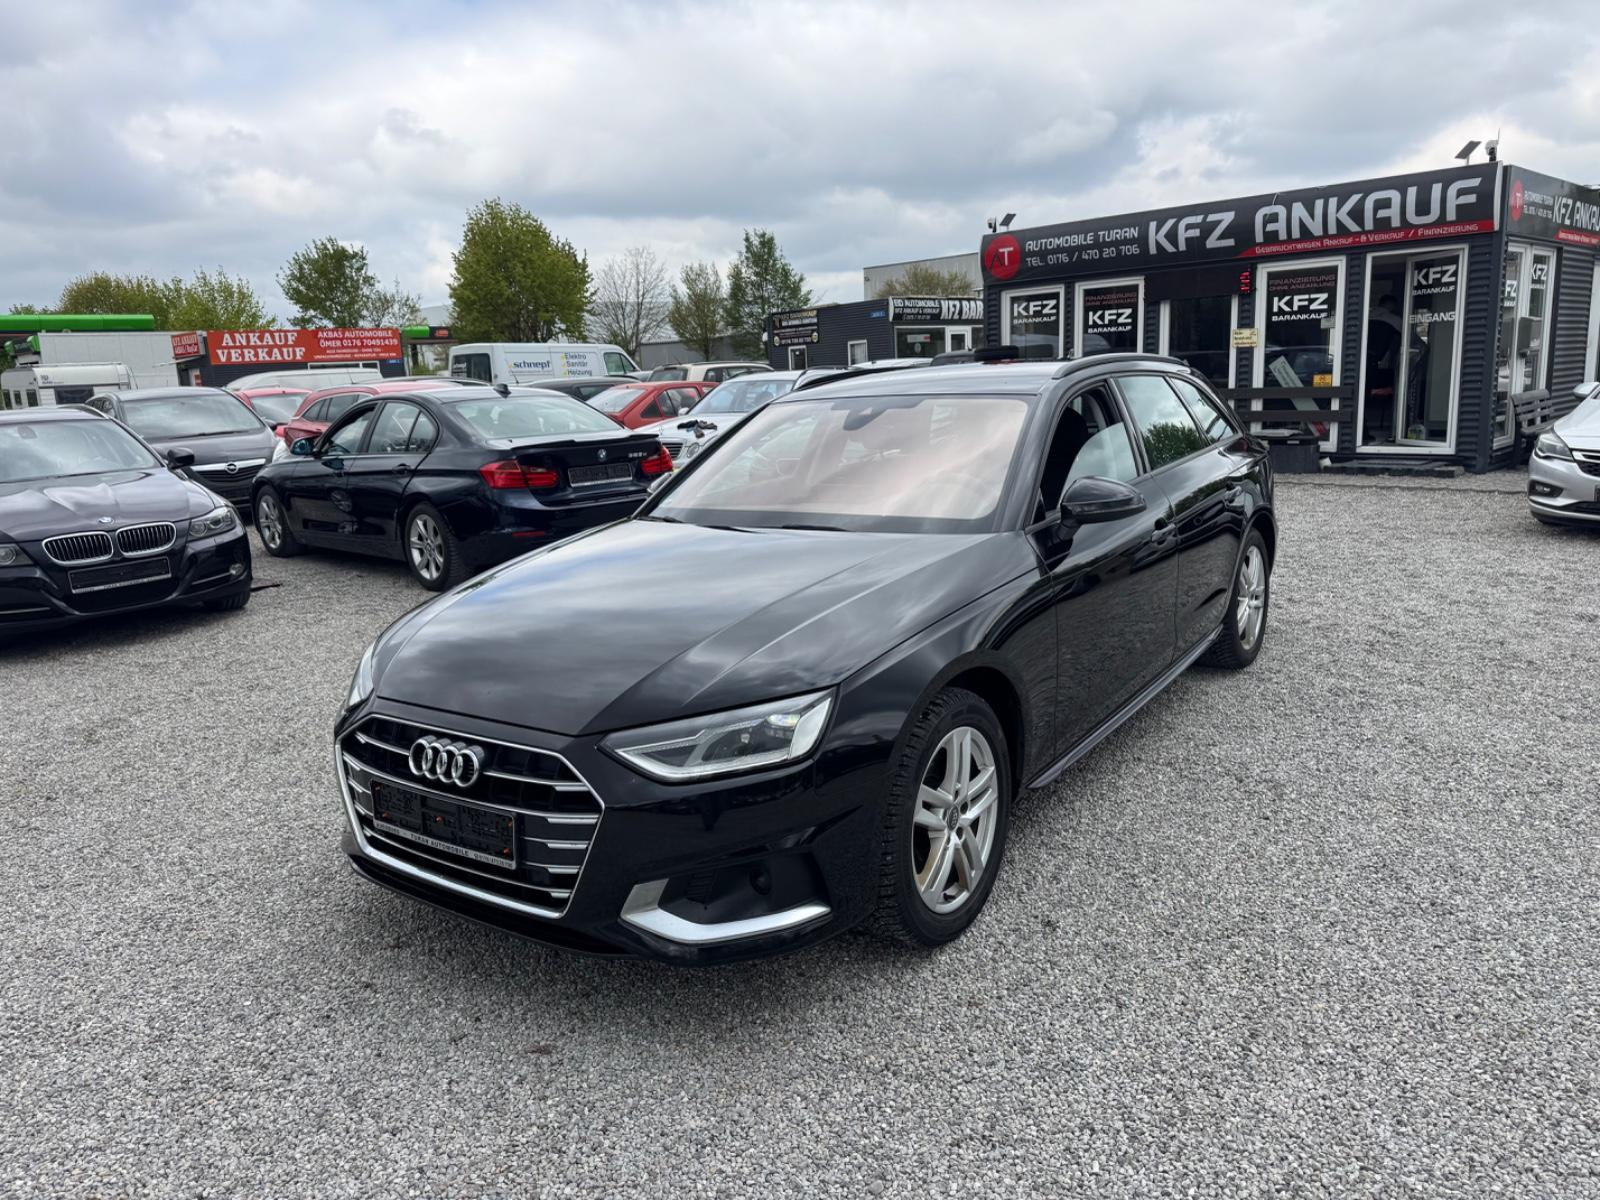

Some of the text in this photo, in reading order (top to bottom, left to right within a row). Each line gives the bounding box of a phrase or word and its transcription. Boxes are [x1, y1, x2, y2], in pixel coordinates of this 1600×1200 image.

[1148, 177, 1482, 255] KFZ ANKAUF
[1553, 195, 1573, 226] KFZ
[1025, 226, 1139, 252] AUTOMOBILE TURAN
[1047, 252, 1069, 265] 0176
[1072, 251, 1079, 262] /
[1082, 249, 1099, 260] 470
[1102, 247, 1117, 258] 20
[1119, 244, 1140, 256] 706
[1412, 264, 1456, 286] KFZ
[1412, 285, 1456, 295] BARANKAUF
[941, 300, 960, 319] KFZ
[1013, 299, 1057, 317] KFZ
[1273, 293, 1328, 312] KFZ
[1013, 315, 1057, 325] BARANKAUF
[1088, 308, 1132, 326] KFZ
[1272, 312, 1328, 322] BARANKAUF
[1408, 311, 1456, 324] EINGANG
[344, 330, 392, 338] AUTOMOBILE
[1087, 325, 1132, 334] BARANKAUF
[221, 332, 298, 347] ANKAUF
[319, 339, 341, 348] ÖMER
[343, 339, 361, 347] 0176
[216, 347, 306, 362] VERKAUF
[565, 352, 586, 360] Elektro
[513, 360, 550, 370] schnepf
[567, 369, 592, 377] Heizung
